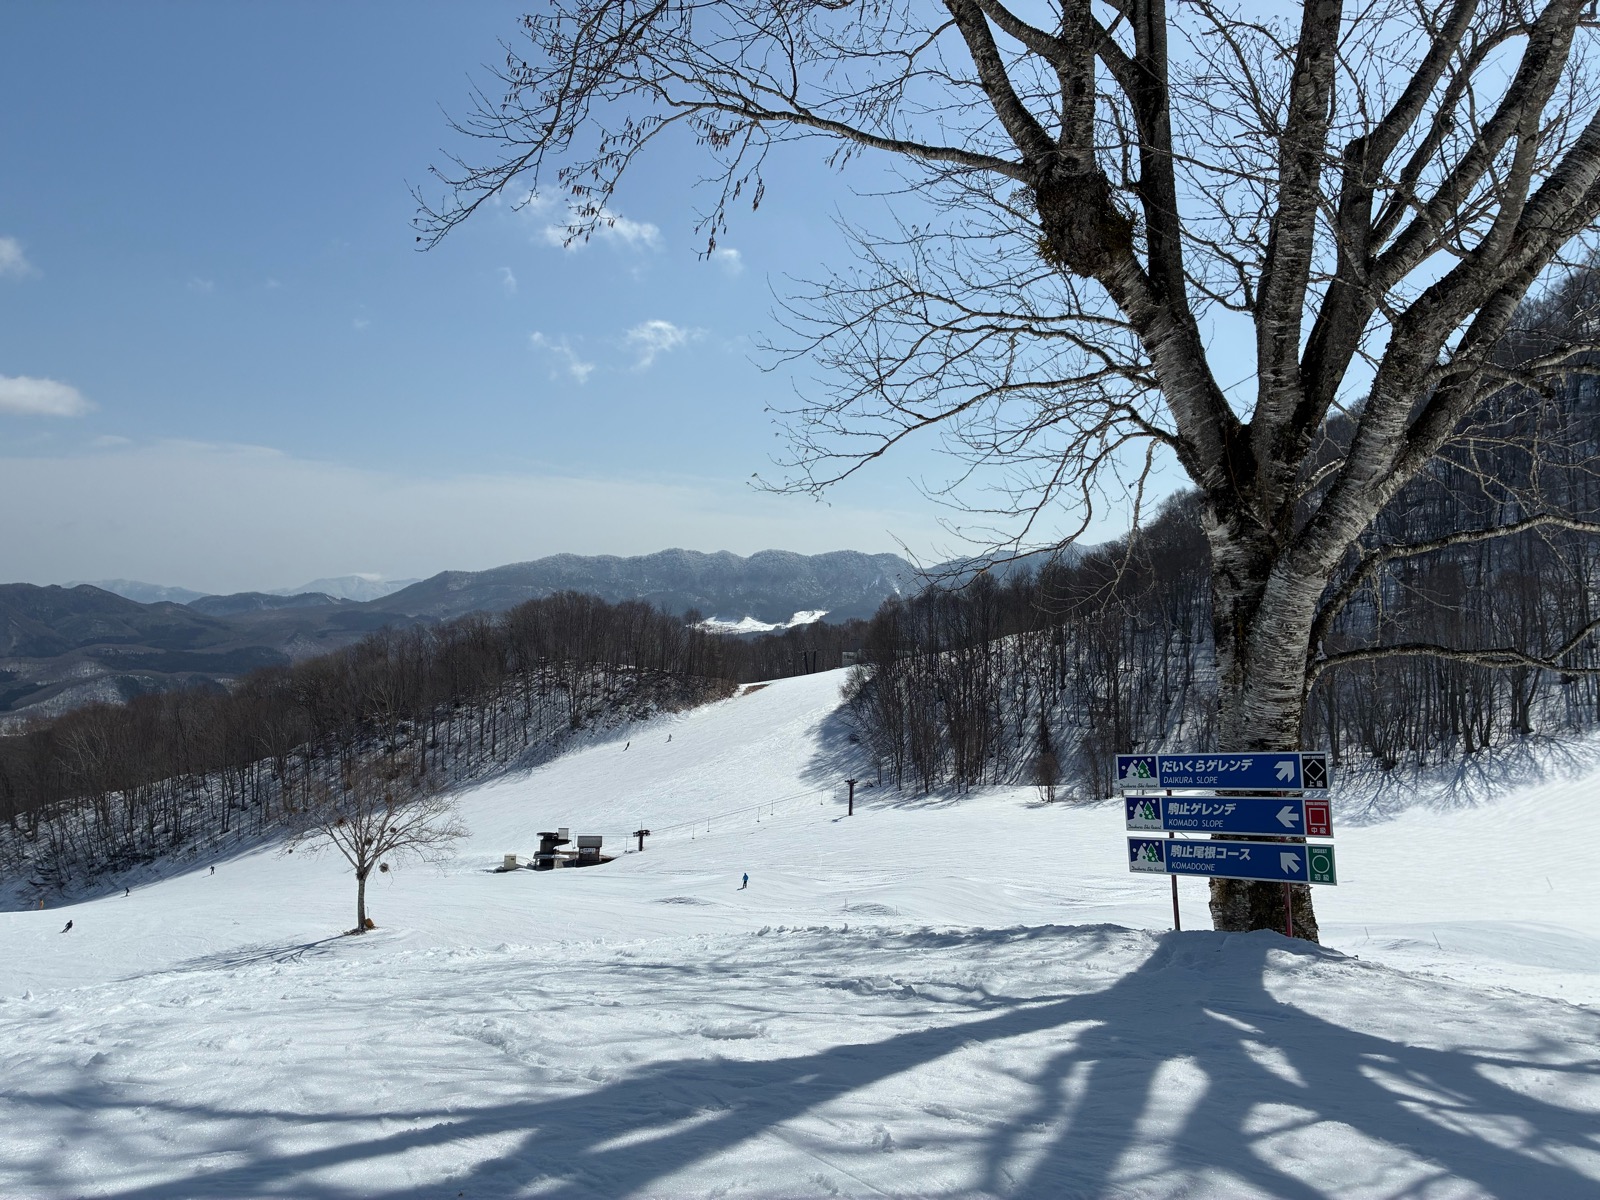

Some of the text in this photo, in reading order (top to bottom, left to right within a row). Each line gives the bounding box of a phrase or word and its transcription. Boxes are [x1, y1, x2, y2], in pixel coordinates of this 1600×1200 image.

[1161, 759, 1253, 773] だいくらゲレンデ
[1163, 776, 1218, 784] DAIKURA SLOPE
[1167, 802, 1236, 816] 駒止ゲレンデ
[1168, 818, 1224, 828] KOMADO SLOPE
[1170, 844, 1251, 861] 駒止尾根コース
[1171, 861, 1215, 871] KOMADOONE
